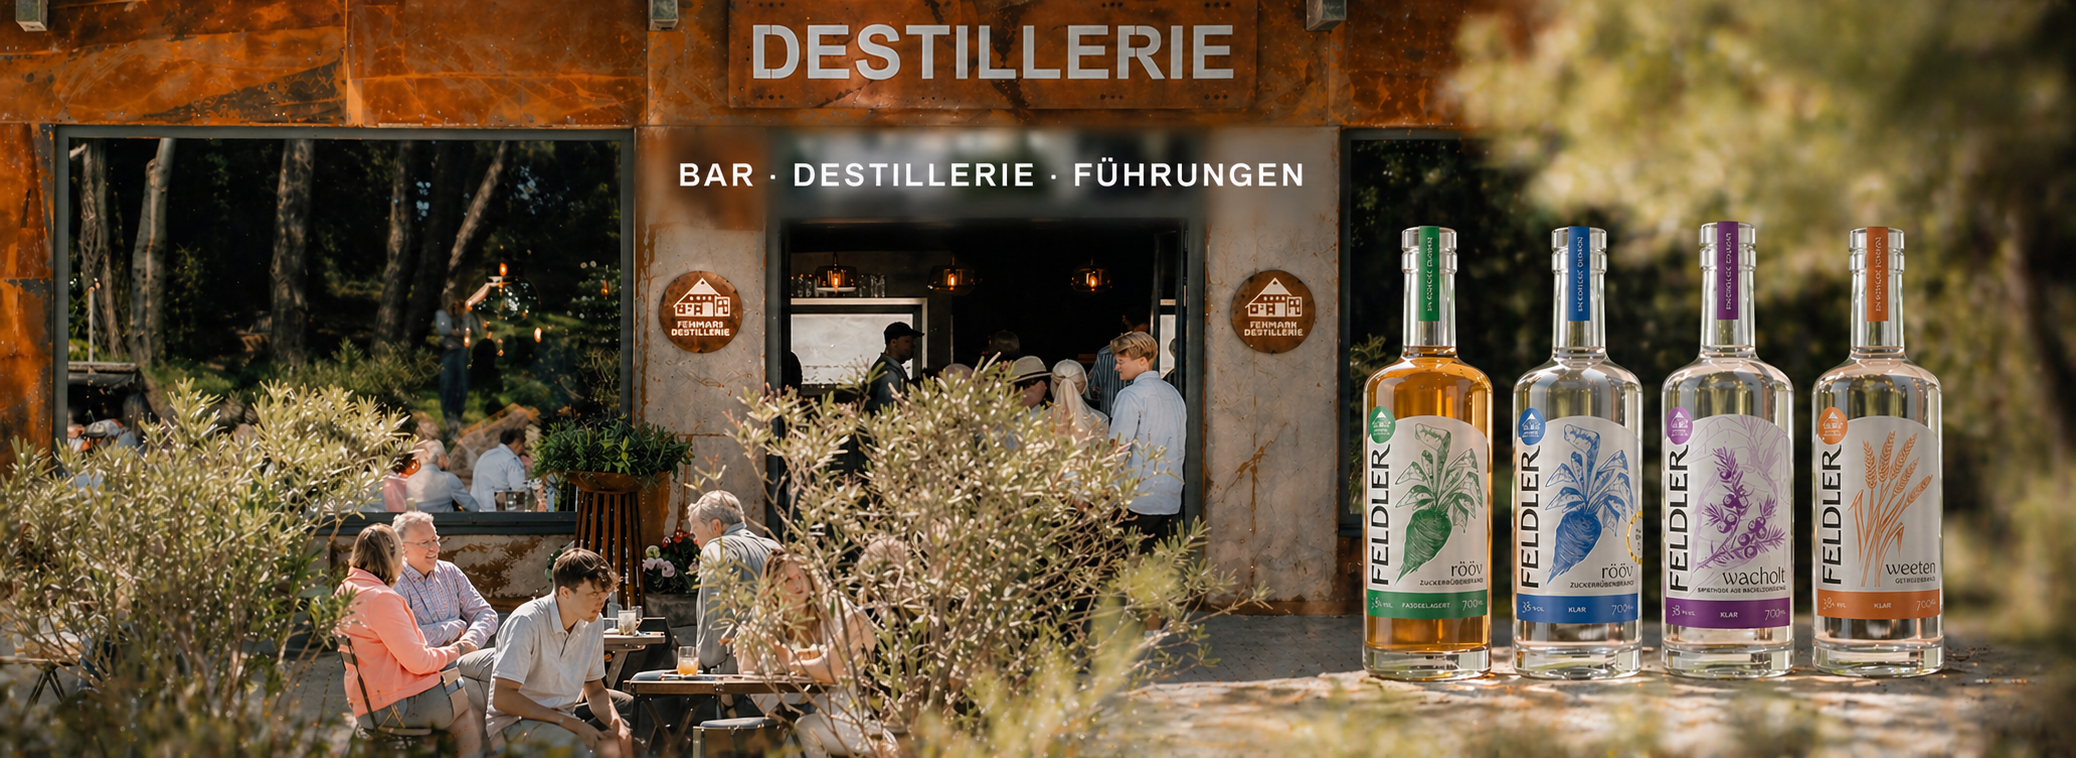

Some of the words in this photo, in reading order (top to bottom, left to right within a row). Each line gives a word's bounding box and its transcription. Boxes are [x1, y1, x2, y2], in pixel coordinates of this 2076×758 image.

[752, 24, 1234, 80] DESTILLERIE
[1371, 444, 1391, 586] FELDLER
[1521, 445, 1540, 589] FELDLER
[1669, 444, 1689, 592] FELDLER
[1822, 444, 1842, 585] FELDLER
[1451, 561, 1483, 577] rööv
[1601, 563, 1634, 579] rööv
[1722, 566, 1785, 585] wacholt
[1886, 561, 1936, 575] weeten
